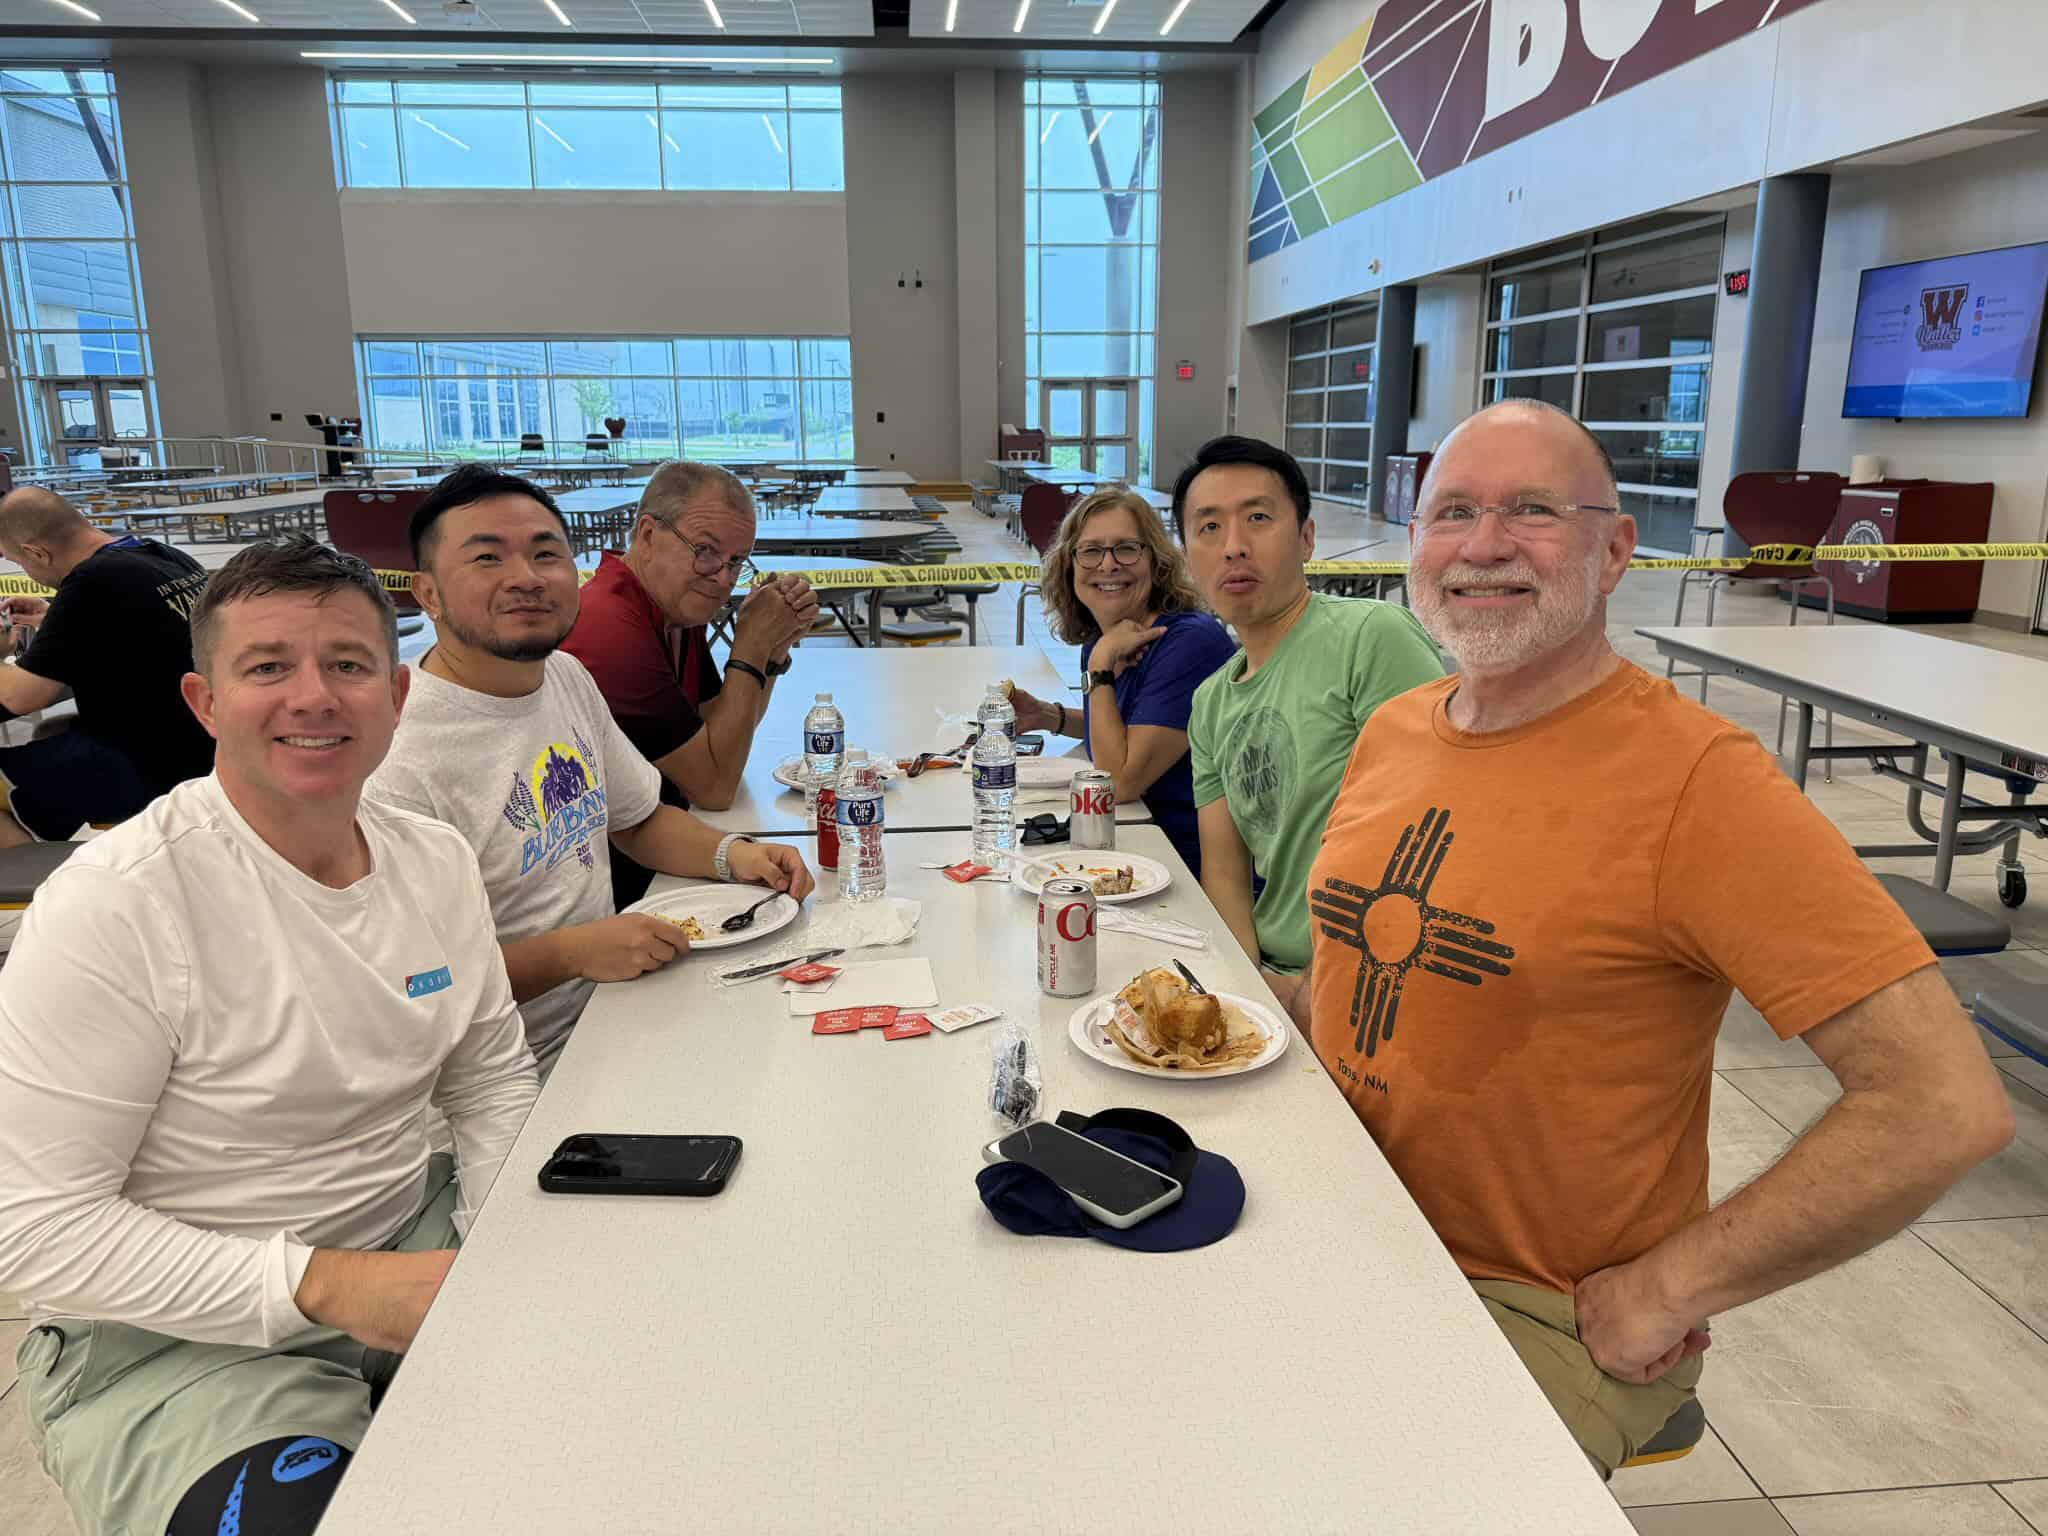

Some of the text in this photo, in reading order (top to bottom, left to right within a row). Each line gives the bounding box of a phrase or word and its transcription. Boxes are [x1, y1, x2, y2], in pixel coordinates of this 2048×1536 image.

[1240, 766, 1279, 799] WOODS
[852, 801, 872, 809] Pure
[854, 808, 871, 818] Life
[1071, 787, 1115, 815] oke
[1056, 902, 1097, 942] Co
[1364, 1072, 1388, 1095] NM
